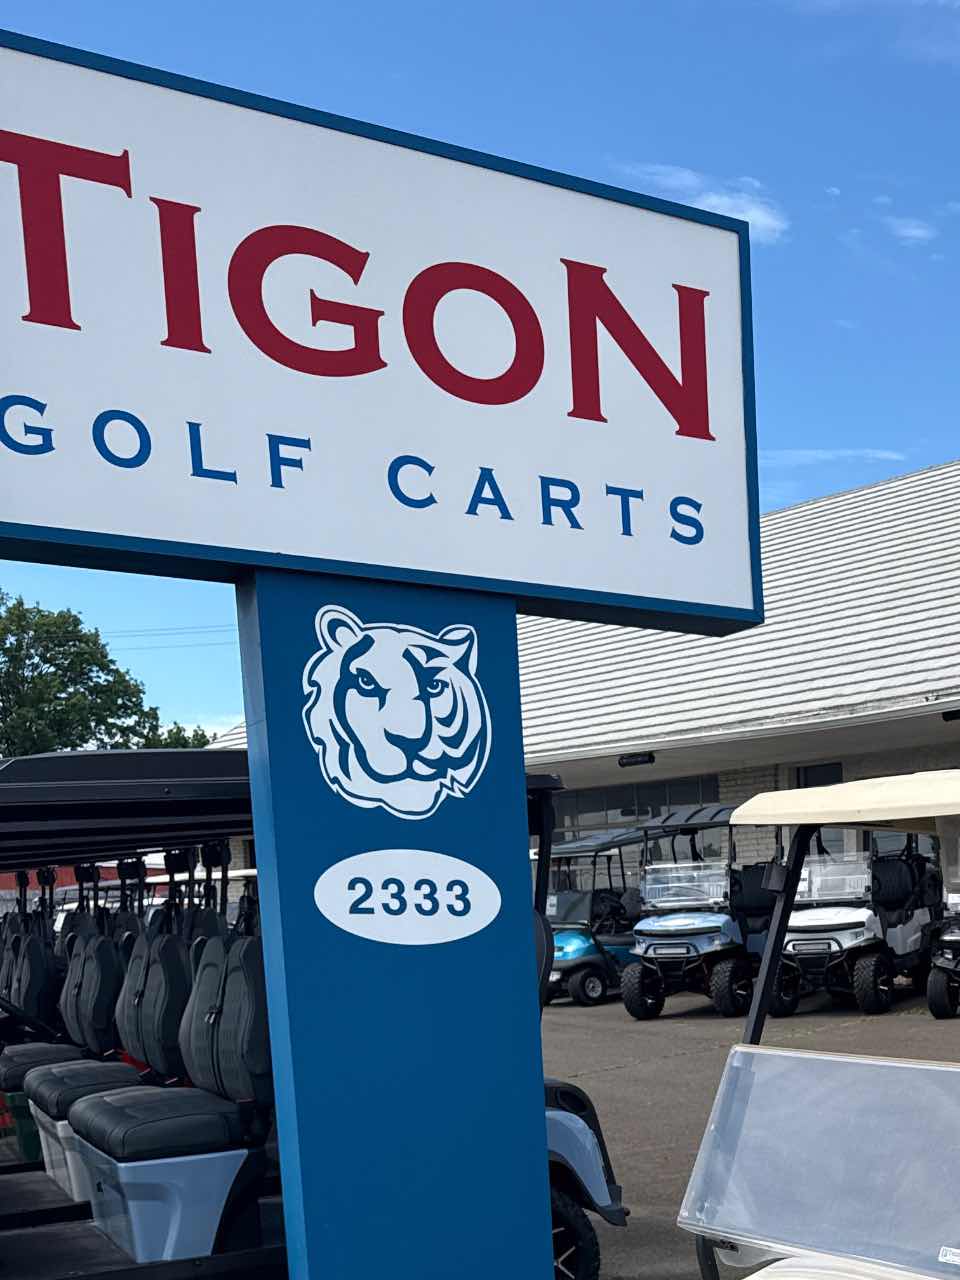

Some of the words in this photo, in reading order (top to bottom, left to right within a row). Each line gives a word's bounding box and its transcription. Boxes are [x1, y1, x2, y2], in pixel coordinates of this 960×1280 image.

[0, 130, 714, 441] TIGON
[0, 394, 312, 490] GOLF
[387, 455, 705, 545] CARTS
[347, 876, 472, 917] 2333
